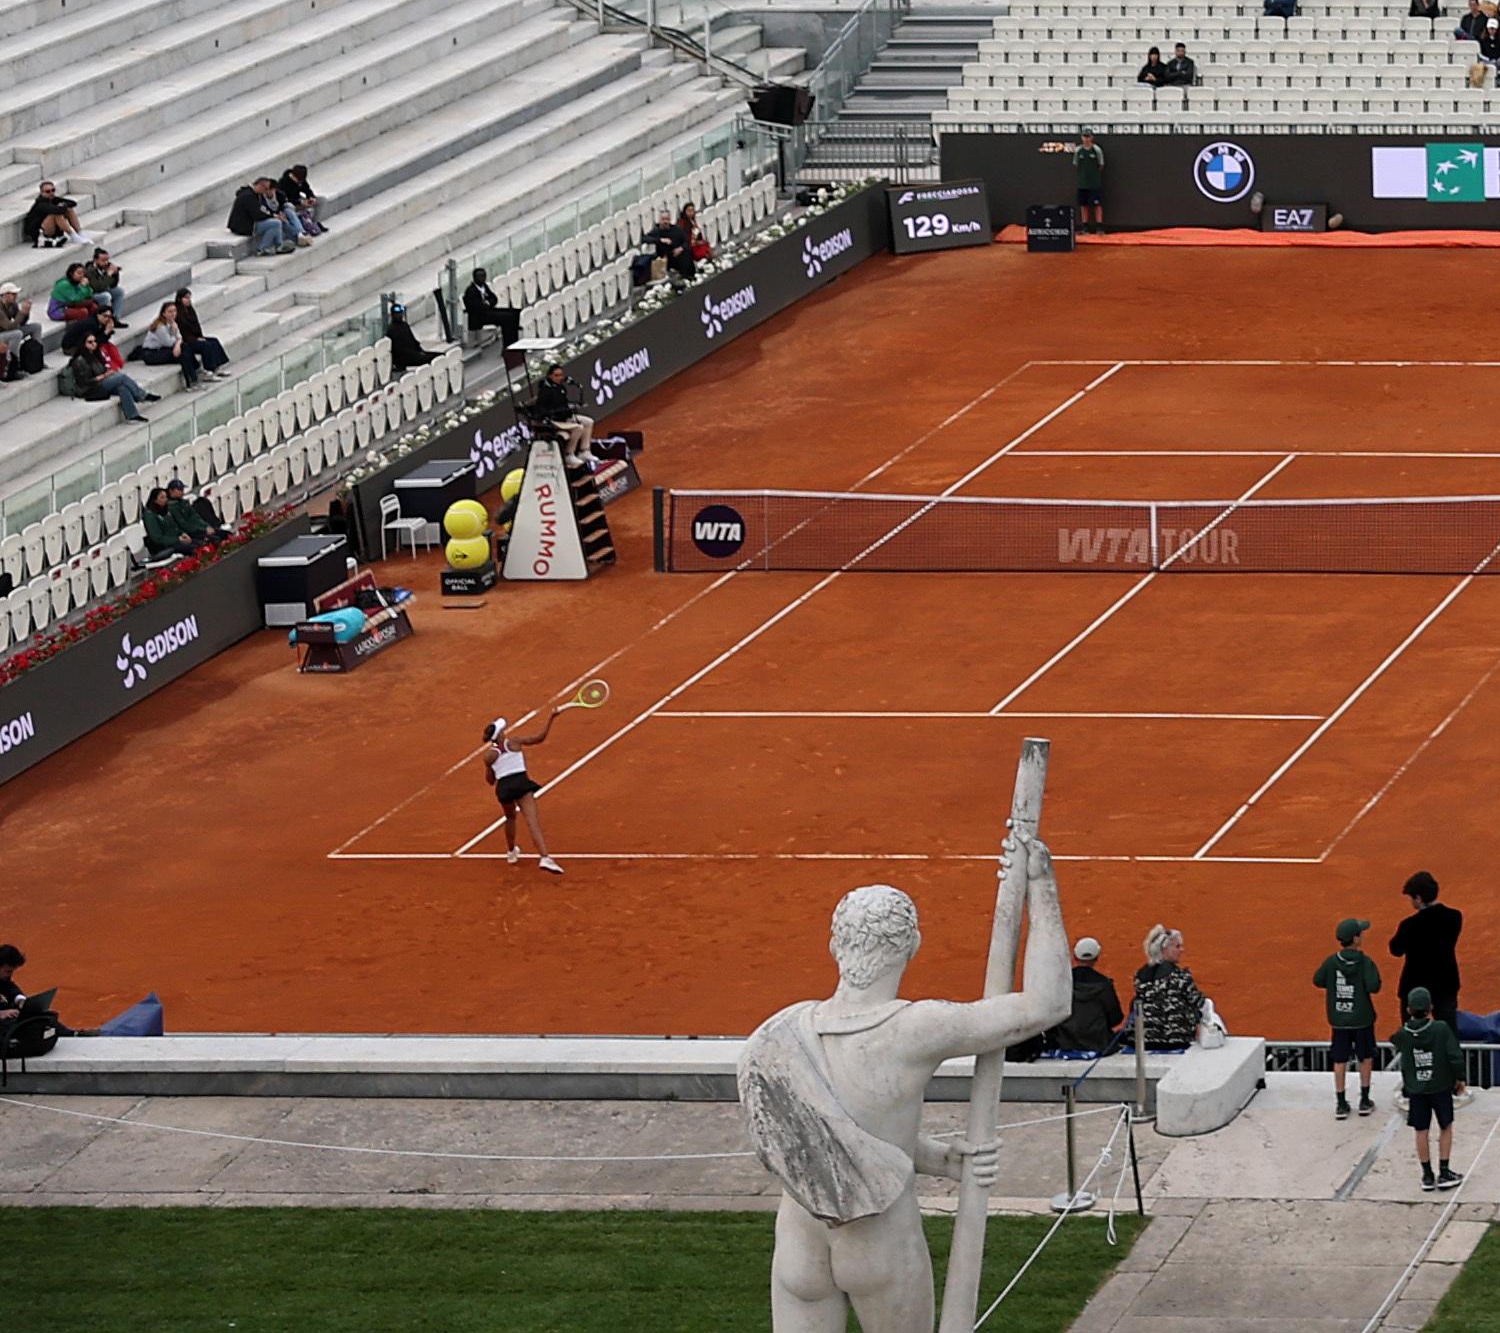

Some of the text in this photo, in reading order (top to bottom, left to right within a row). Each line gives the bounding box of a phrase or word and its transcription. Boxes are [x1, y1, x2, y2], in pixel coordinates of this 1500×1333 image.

[903, 213, 951, 239] 129
[1274, 209, 1314, 226] EA7
[532, 483, 558, 577] RUMMO
[694, 521, 742, 542] WTA
[1058, 527, 1240, 565] WTA TOUR
[444, 576, 477, 586] OFFICIAL
[450, 584, 469, 592] BALL
[1335, 1001, 1354, 1013] EA7
